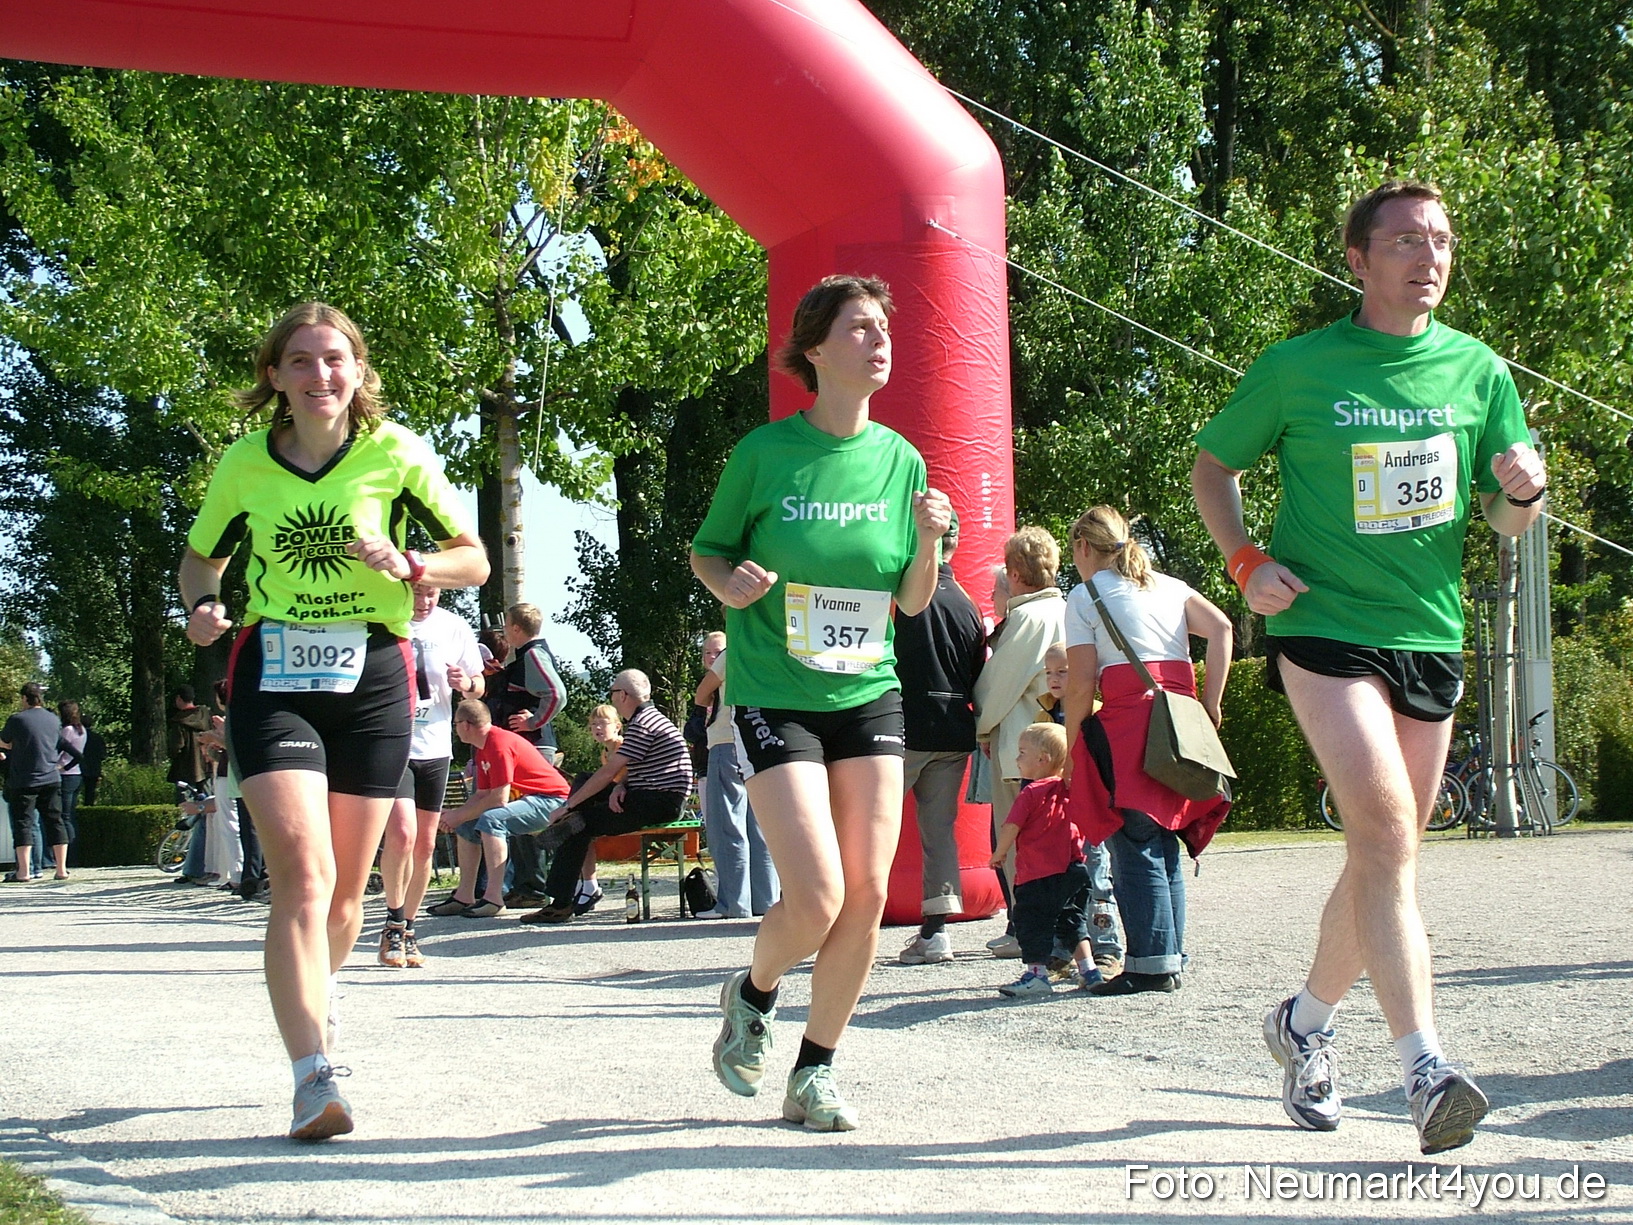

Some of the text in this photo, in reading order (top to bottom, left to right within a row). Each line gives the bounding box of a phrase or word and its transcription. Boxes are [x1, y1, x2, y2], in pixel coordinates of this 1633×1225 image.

[1333, 400, 1457, 433] Sinupret
[1384, 449, 1439, 468] Andreas
[1358, 479, 1366, 492] D
[1397, 476, 1443, 506] 358
[781, 495, 889, 528] Sinupret
[274, 524, 357, 548] POWER
[294, 544, 347, 560] Team
[294, 592, 365, 605] Kloster-
[814, 593, 861, 613] Yvonne
[286, 605, 377, 621] Apotheke
[790, 616, 797, 628] D
[823, 624, 869, 649] 357
[291, 644, 356, 669] 3092
